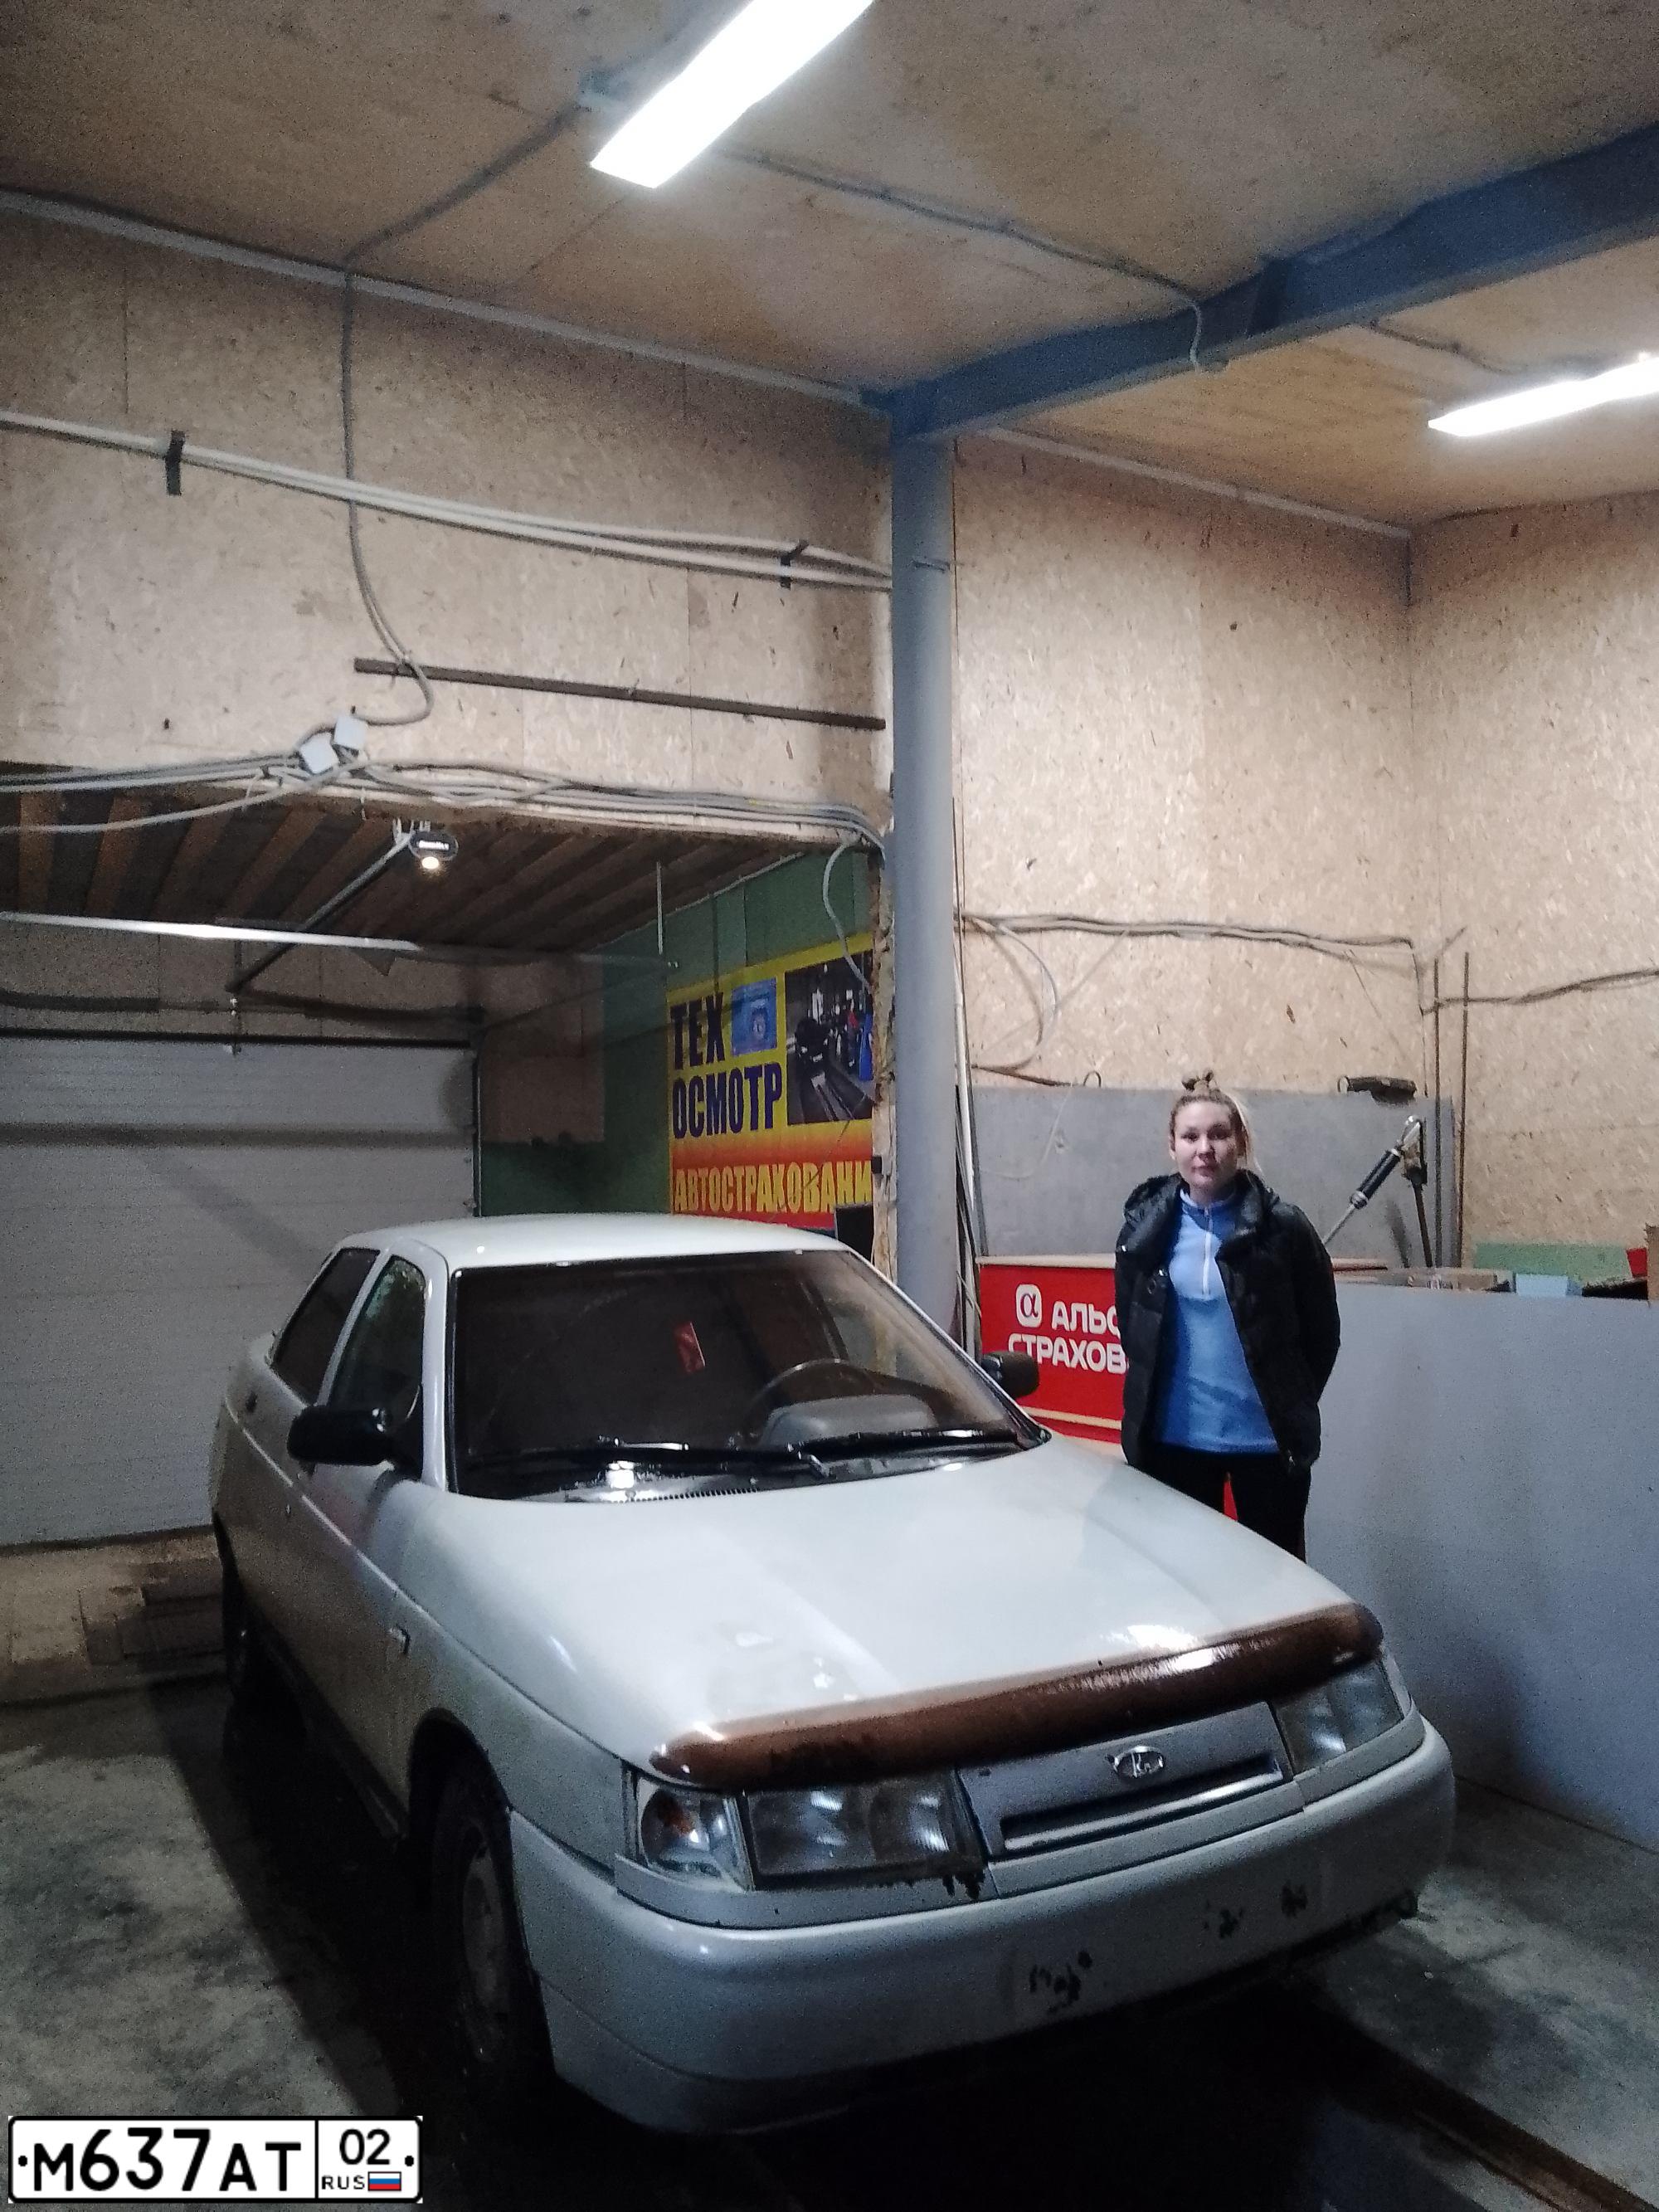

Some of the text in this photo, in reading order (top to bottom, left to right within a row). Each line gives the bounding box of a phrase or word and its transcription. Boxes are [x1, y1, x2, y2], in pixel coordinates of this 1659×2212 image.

[670, 992, 725, 1070] ТЕХ
[672, 1062, 783, 1140] ОСМОТР
[1008, 1333, 1129, 1375] СТРАХОВ
